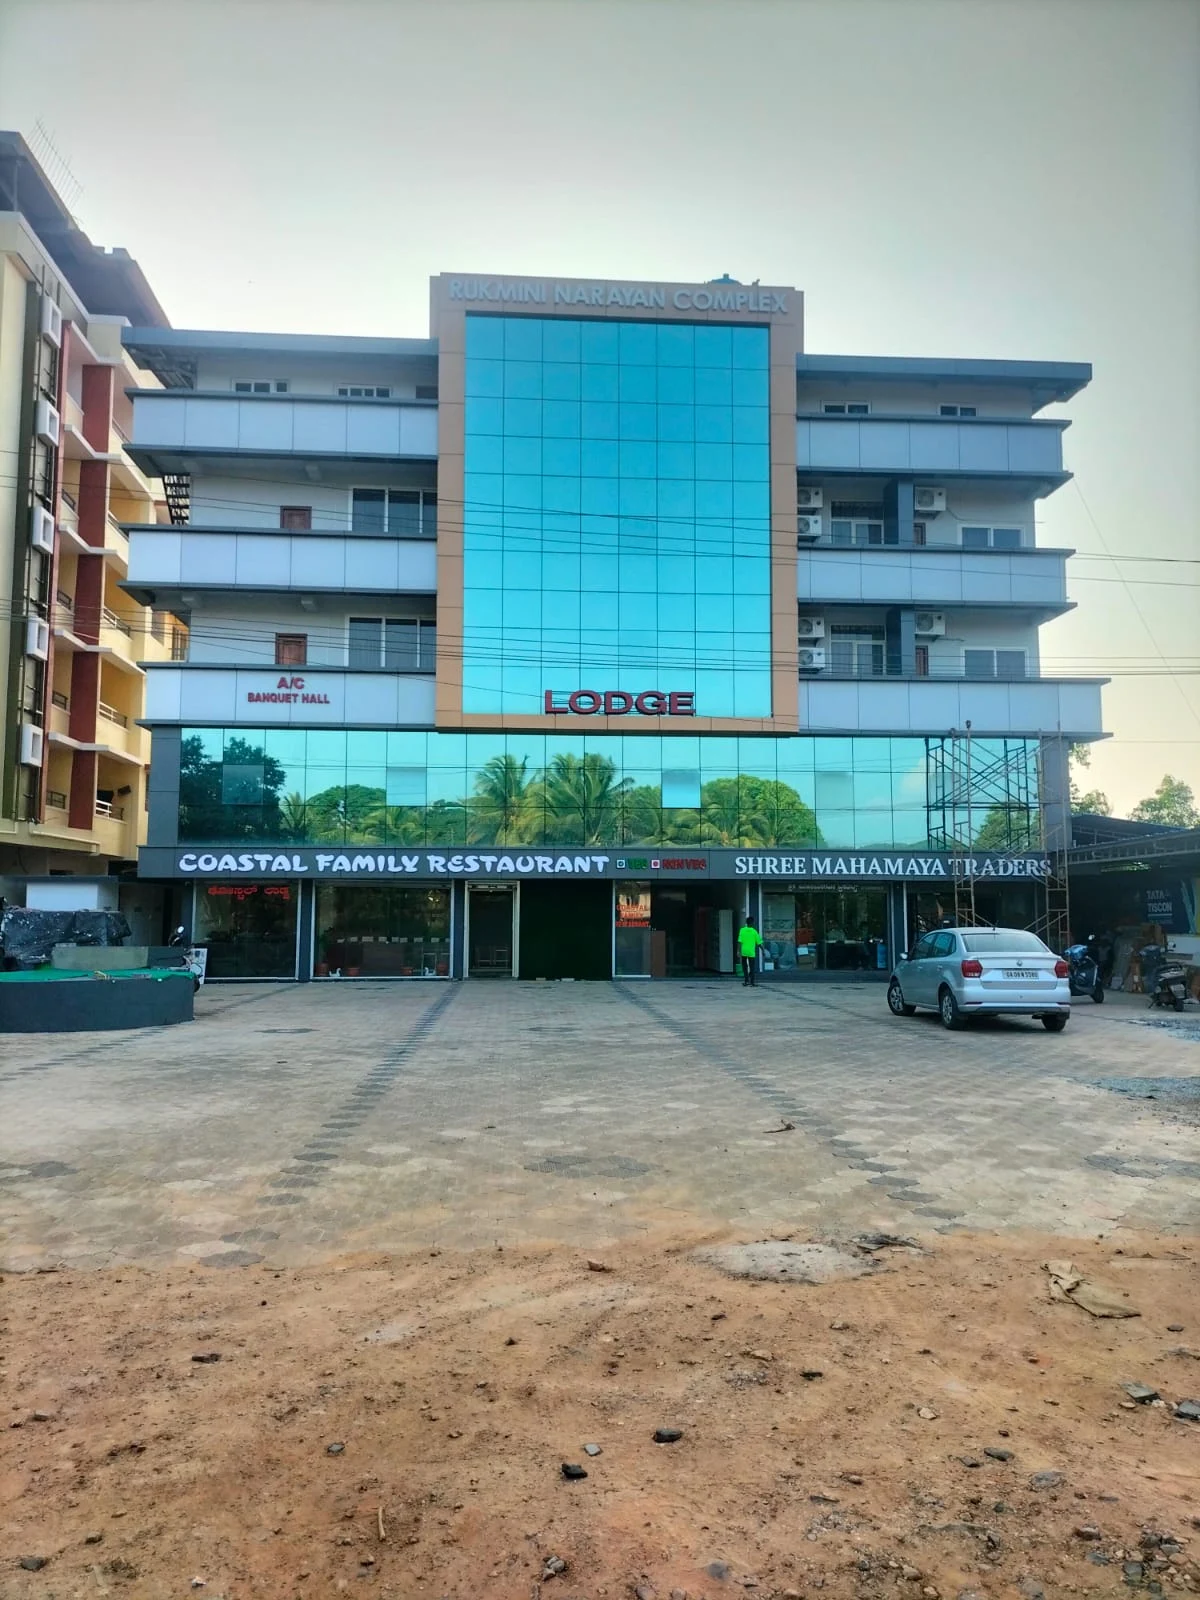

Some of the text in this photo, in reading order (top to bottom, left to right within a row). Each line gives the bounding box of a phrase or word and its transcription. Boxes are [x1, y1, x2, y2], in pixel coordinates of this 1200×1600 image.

[449, 279, 788, 313] RUKMINI NARAYAN COMPLEX
[277, 676, 305, 690] A/C
[247, 692, 330, 704] BANQUET HALL
[545, 690, 696, 715] LODGE
[179, 853, 609, 873] COASTAL FAMILY RESTAURANT
[735, 856, 1052, 877] SHREE MAHAMAYA TRADERS
